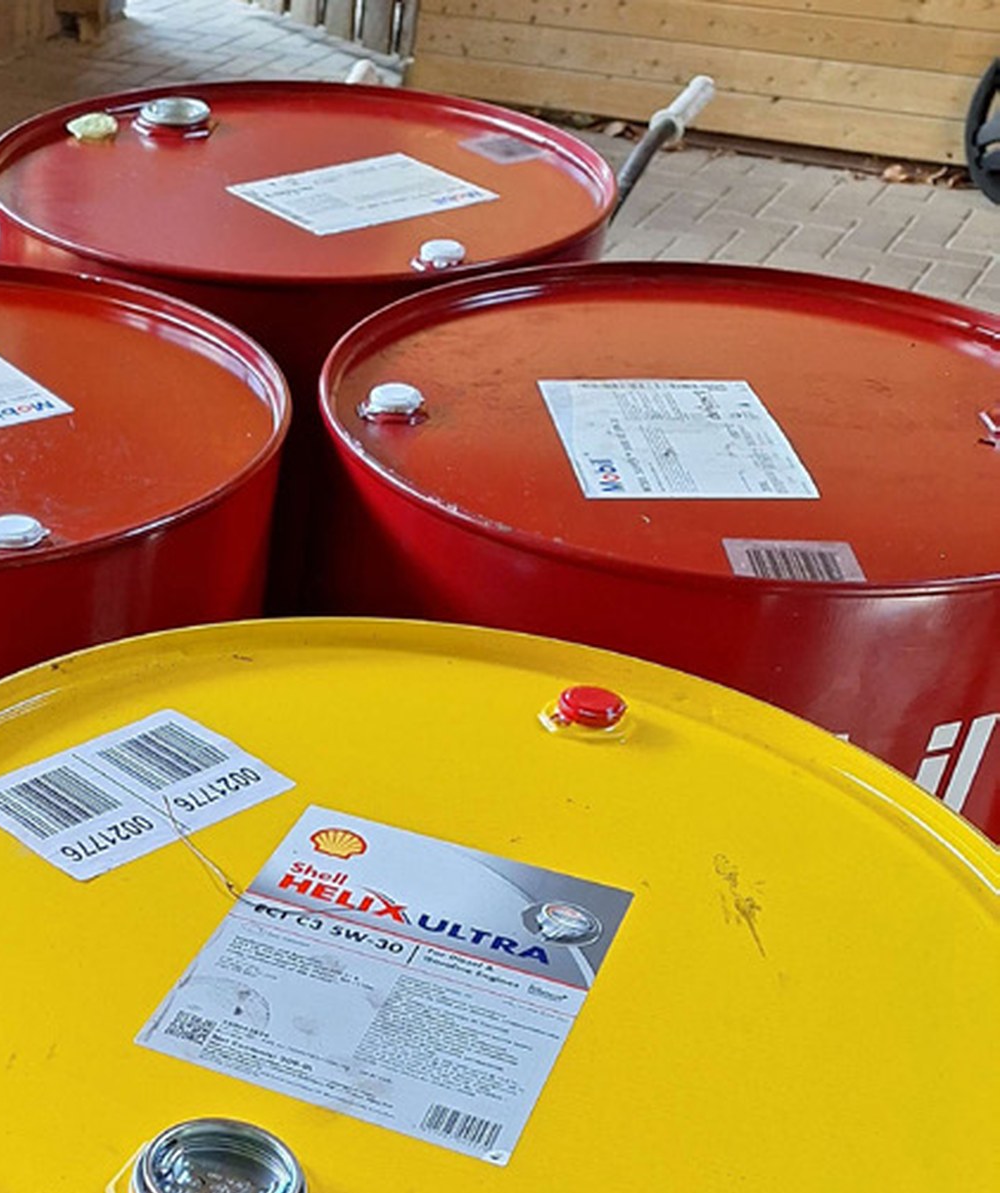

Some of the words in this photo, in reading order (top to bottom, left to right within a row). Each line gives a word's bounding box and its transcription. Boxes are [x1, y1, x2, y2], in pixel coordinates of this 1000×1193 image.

[173, 767, 262, 812] 0021776
[60, 814, 155, 862] 0021776
[289, 861, 349, 886] Shell
[278, 873, 408, 925] HELIX
[417, 914, 551, 965] ULTRA
[295, 911, 323, 931] C3
[328, 923, 405, 956] 5W-30
